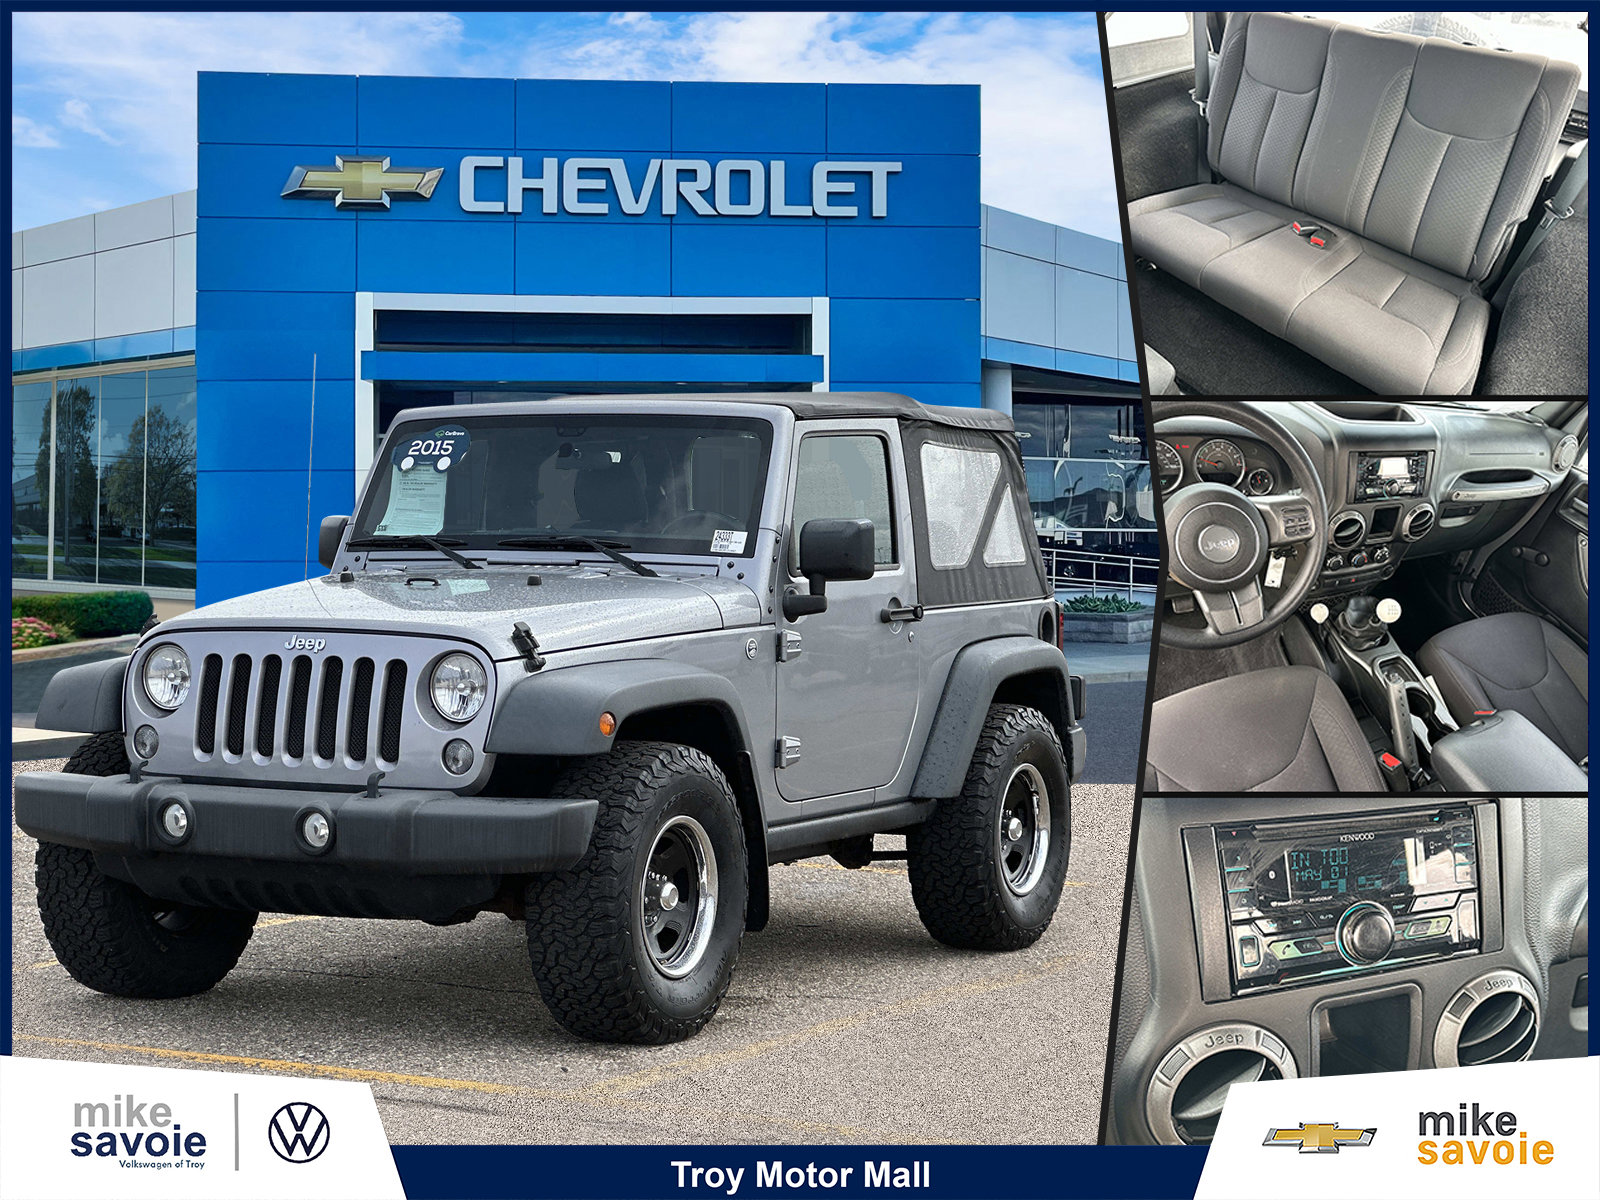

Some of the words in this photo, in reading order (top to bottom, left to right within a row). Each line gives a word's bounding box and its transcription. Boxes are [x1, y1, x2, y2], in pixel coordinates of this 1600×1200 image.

[459, 156, 902, 217] CHEVROLET
[408, 440, 454, 455] 2015
[1204, 537, 1235, 550] Jeep
[284, 634, 326, 654] Jeep
[1340, 832, 1375, 842] KENWOOD
[1291, 852, 1310, 870] IN
[1295, 869, 1322, 882] MAY
[1484, 979, 1514, 991] Jeep
[1205, 1033, 1244, 1048] Jeep
